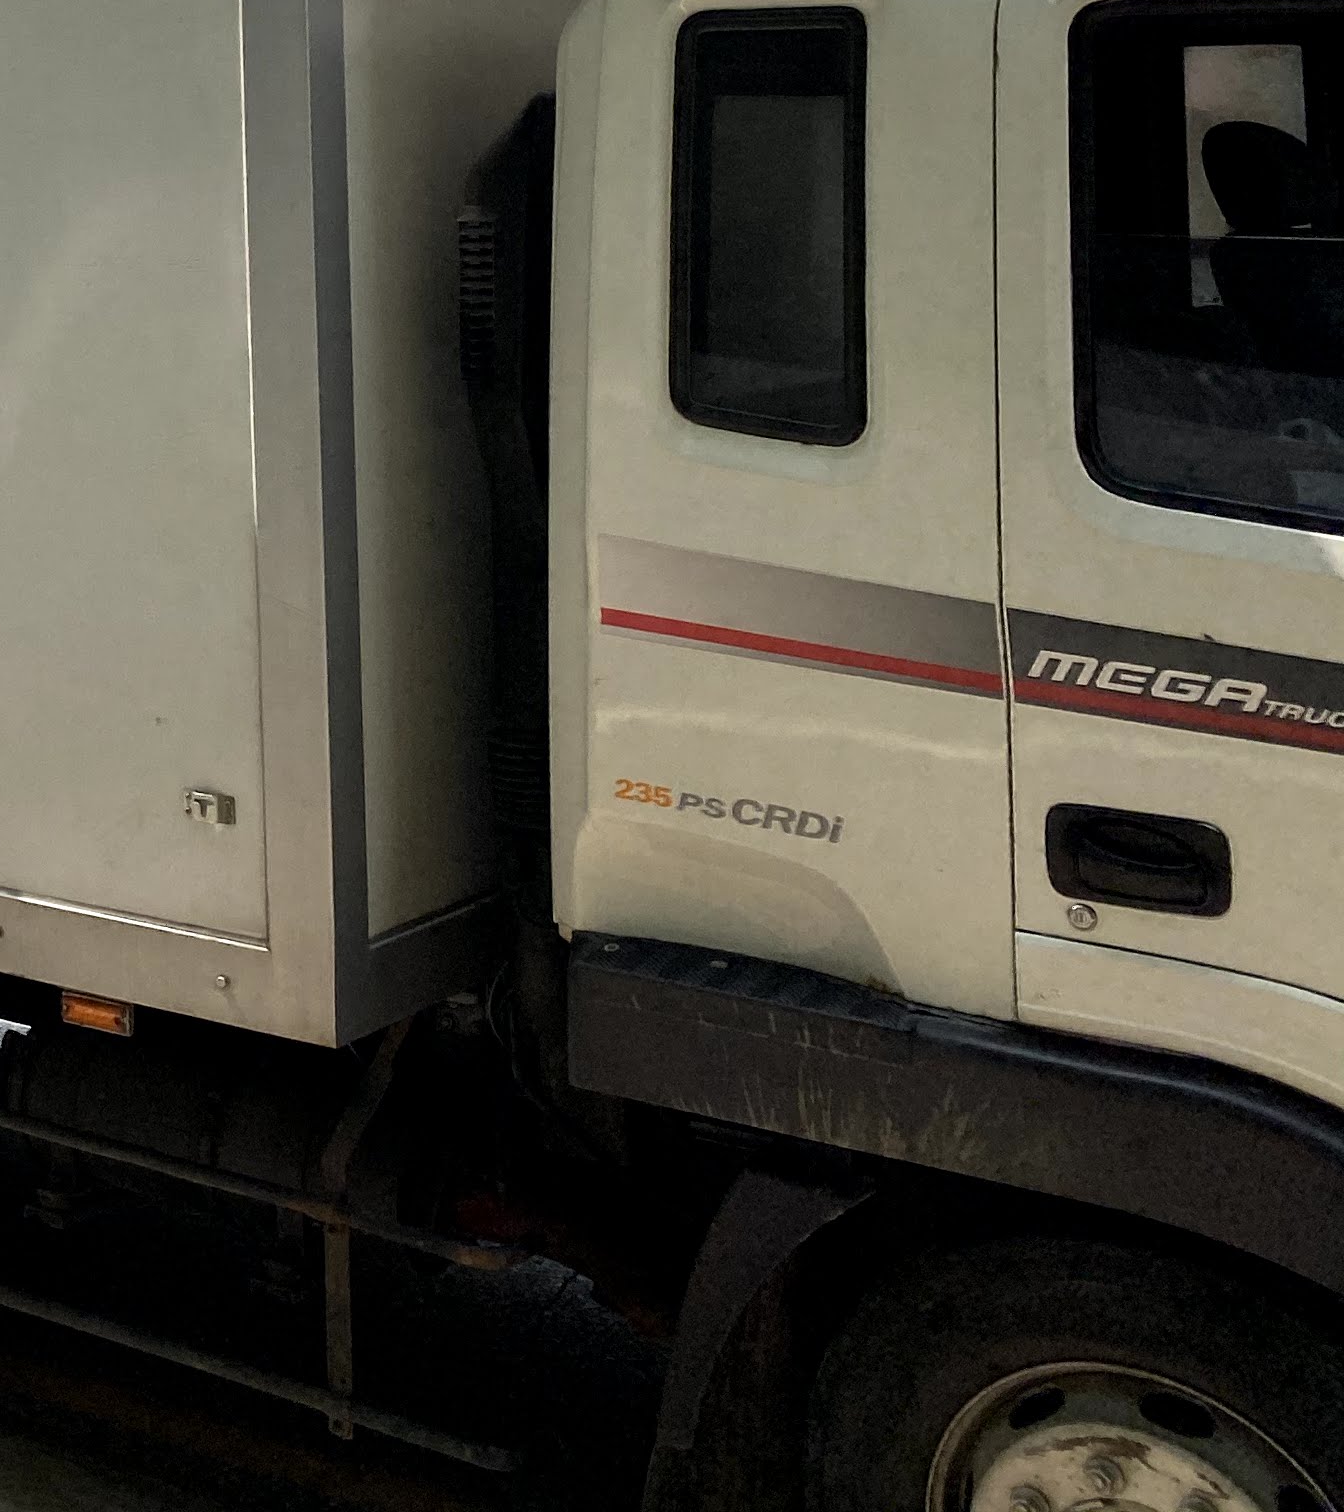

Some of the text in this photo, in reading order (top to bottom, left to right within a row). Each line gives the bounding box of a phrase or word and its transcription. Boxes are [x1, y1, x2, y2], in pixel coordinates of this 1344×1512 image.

[1027, 649, 1268, 714] MEGA
[614, 778, 845, 844] 235 PS CRDi
